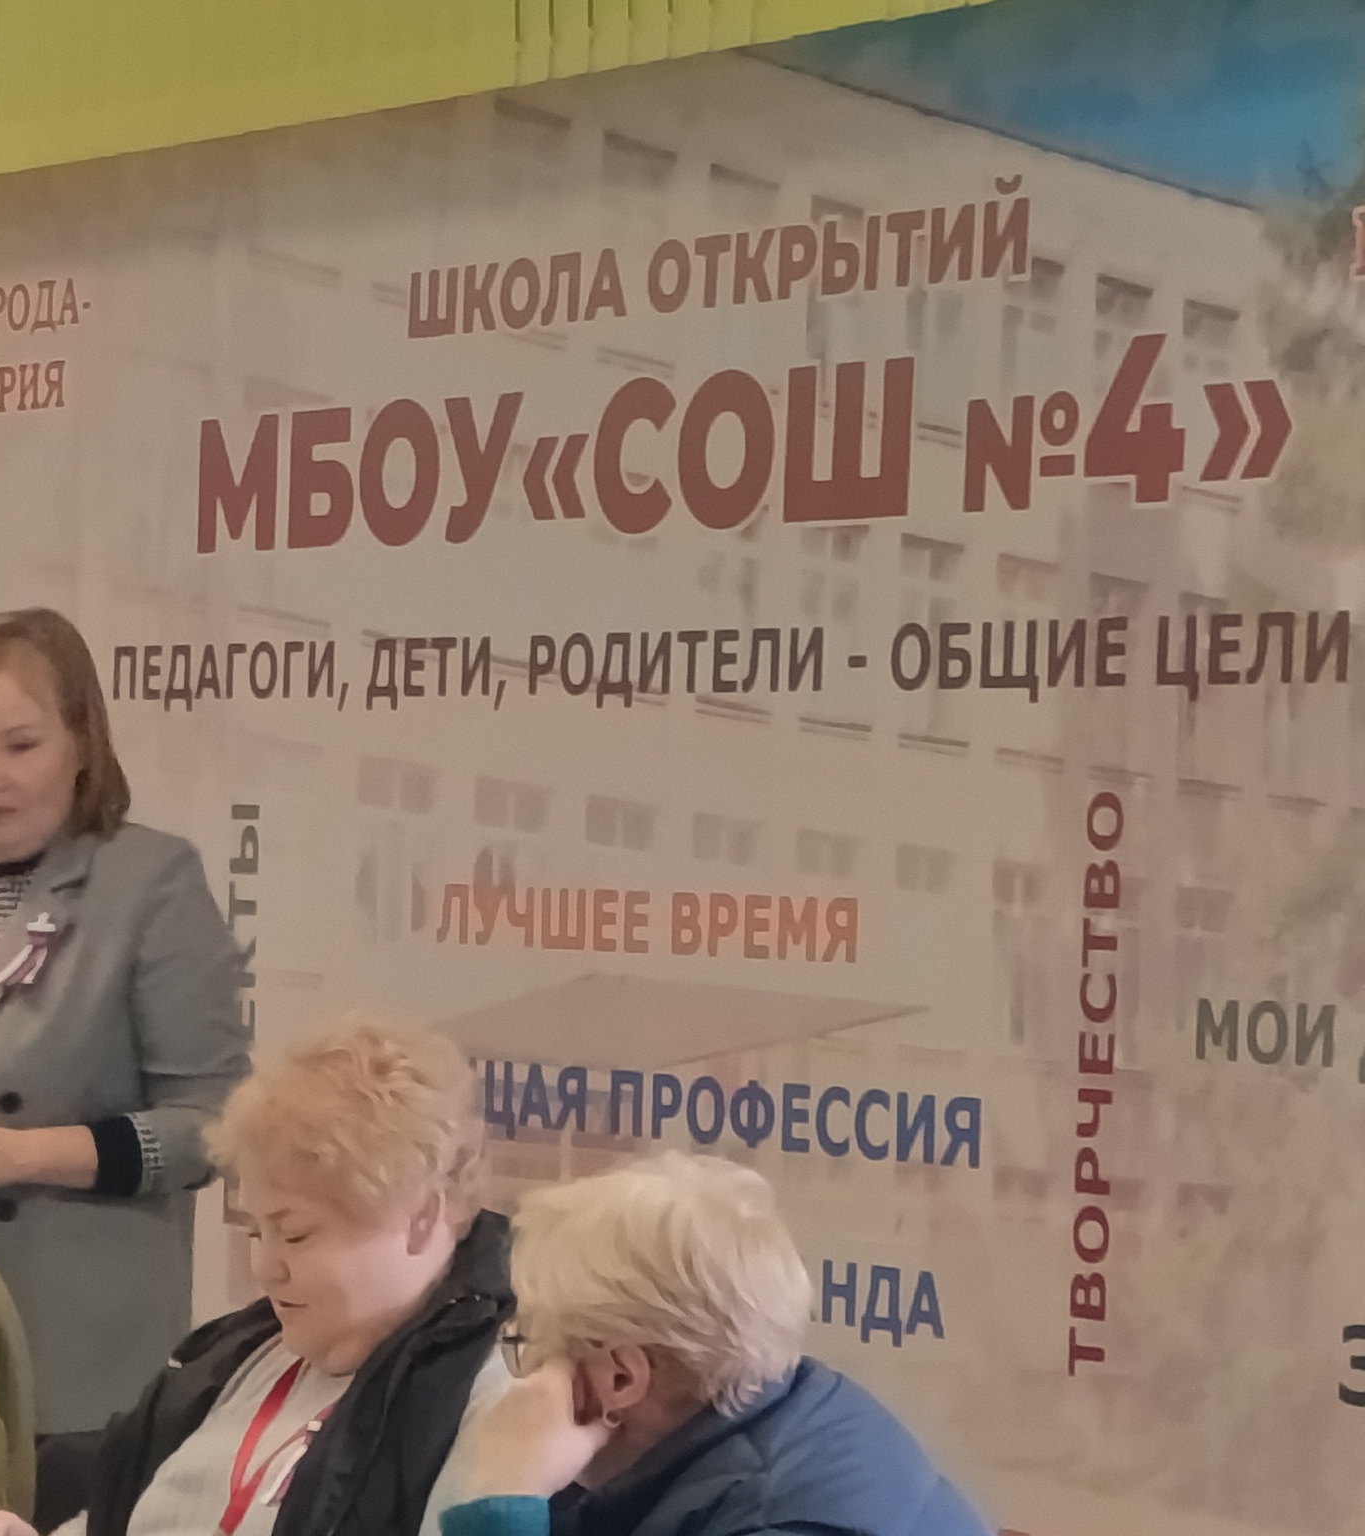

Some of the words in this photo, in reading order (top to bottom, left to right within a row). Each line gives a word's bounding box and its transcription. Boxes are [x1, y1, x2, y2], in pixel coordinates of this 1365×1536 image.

[408, 248, 627, 338] ШКОЛА
[647, 174, 1031, 314] ОТКРЫТИЙ
[111, 639, 348, 712] ПЕДАГОГИ,
[366, 637, 507, 711] ДЕТИ,
[527, 626, 825, 708] РОДИТЕЛИ
[890, 616, 1129, 703] ОБЩИЕ
[1155, 610, 1351, 702] ЦЕЛИ
[436, 883, 651, 953] ЛУЧШЕЕ
[671, 891, 859, 963] ВРЕМЯ
[1195, 998, 1337, 1068] МОИ
[610, 1069, 983, 1169] ПРОФЕССИЯ
[1068, 791, 1125, 1377] ТВОРЧЕСТВО
[810, 1259, 945, 1348] НДА
